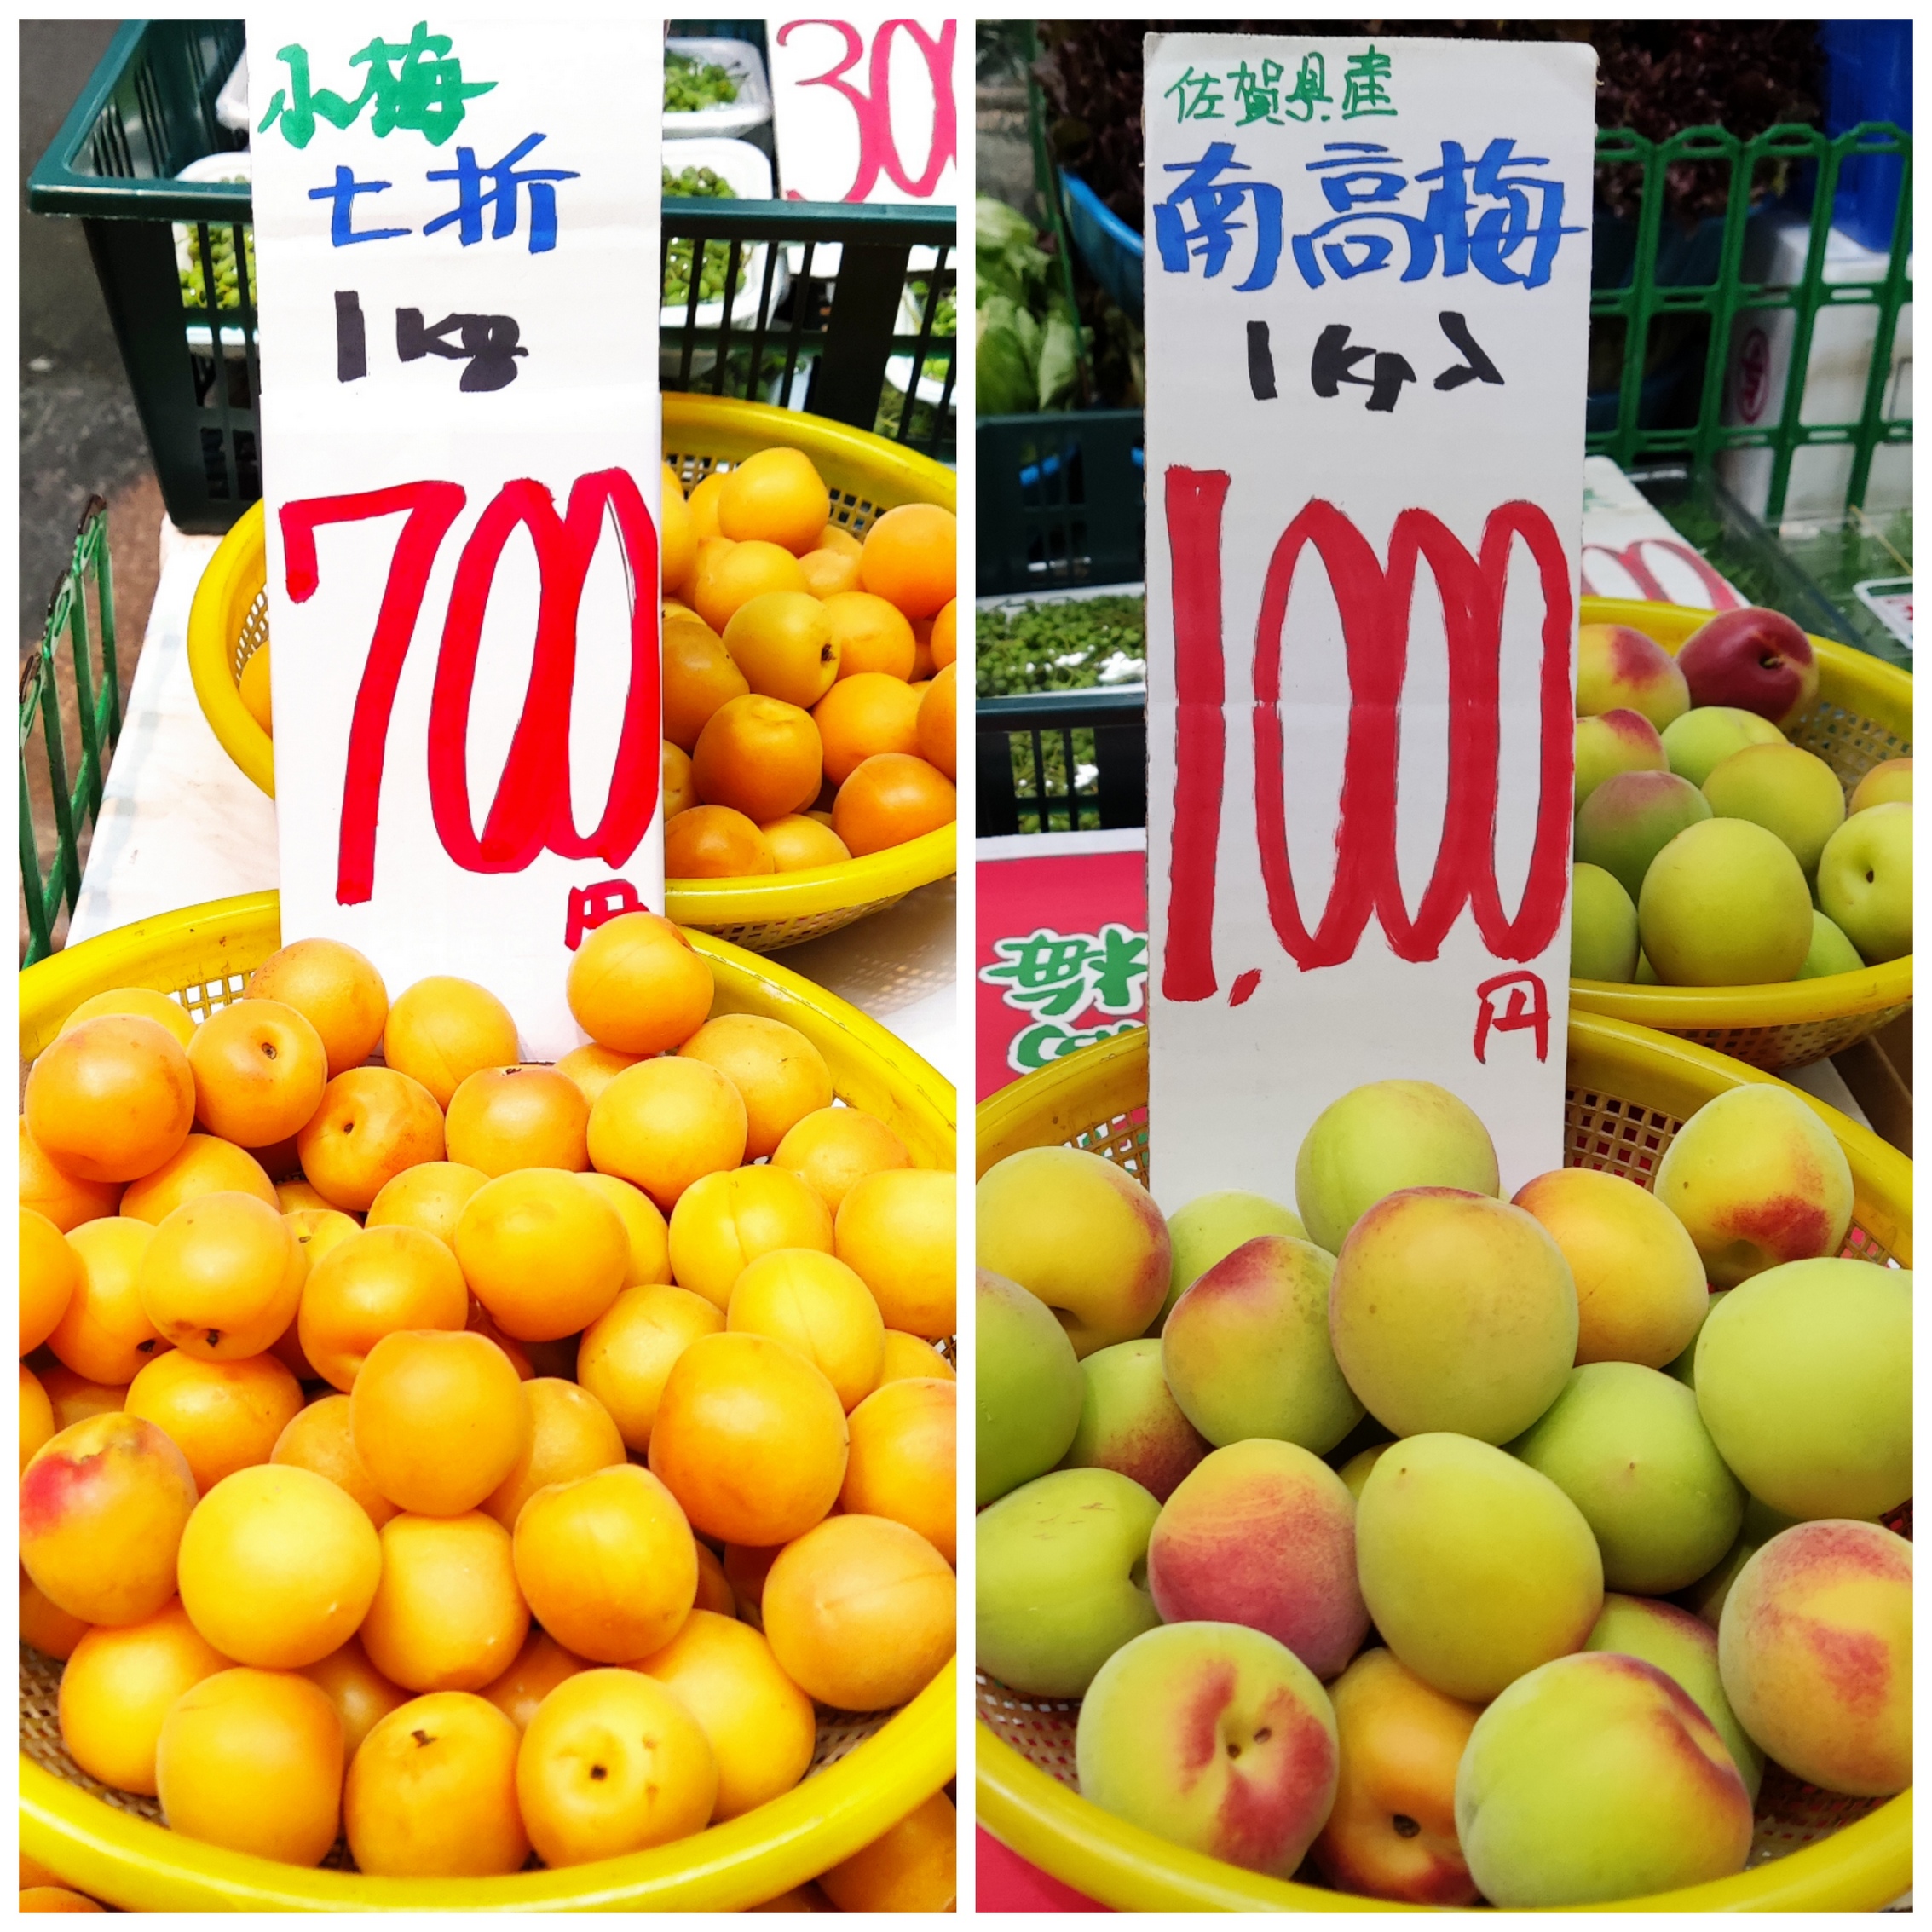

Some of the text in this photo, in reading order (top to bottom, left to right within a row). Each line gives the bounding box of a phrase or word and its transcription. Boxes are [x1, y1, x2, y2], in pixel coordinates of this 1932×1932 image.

[257, 20, 498, 149] 小梅
[776, 20, 956, 203] 30
[1164, 44, 1398, 127] 佐賀県産
[309, 133, 580, 254] 七折
[1152, 138, 1587, 292] 南高梅
[279, 467, 659, 905] 700
[1474, 970, 1551, 1064] 円
